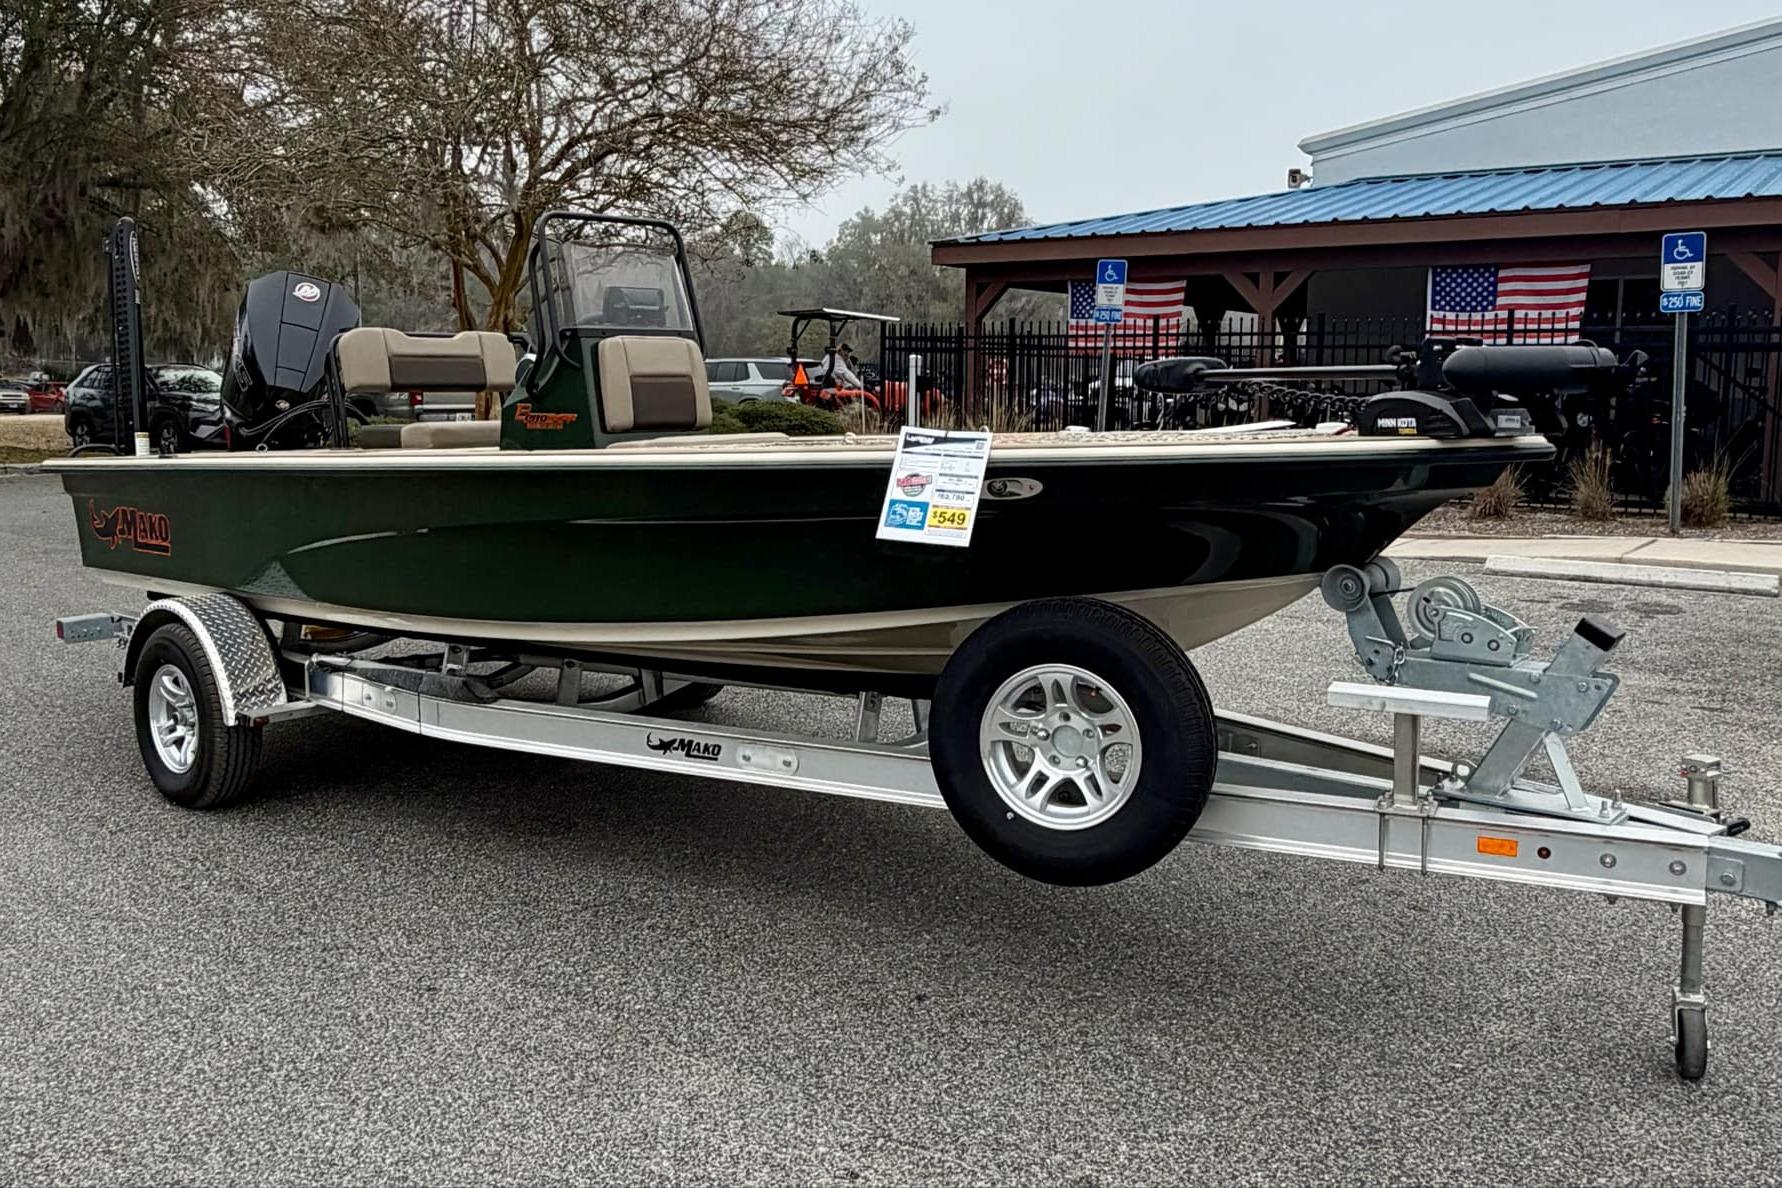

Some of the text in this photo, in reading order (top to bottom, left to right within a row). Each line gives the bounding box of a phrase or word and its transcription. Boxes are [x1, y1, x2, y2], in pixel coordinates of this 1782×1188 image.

[1685, 295, 1701, 308] FINE
[1377, 417, 1417, 428] MINN KOTA
[932, 510, 967, 526] $549
[116, 506, 171, 556] MAKO
[672, 738, 722, 761] MAKO
